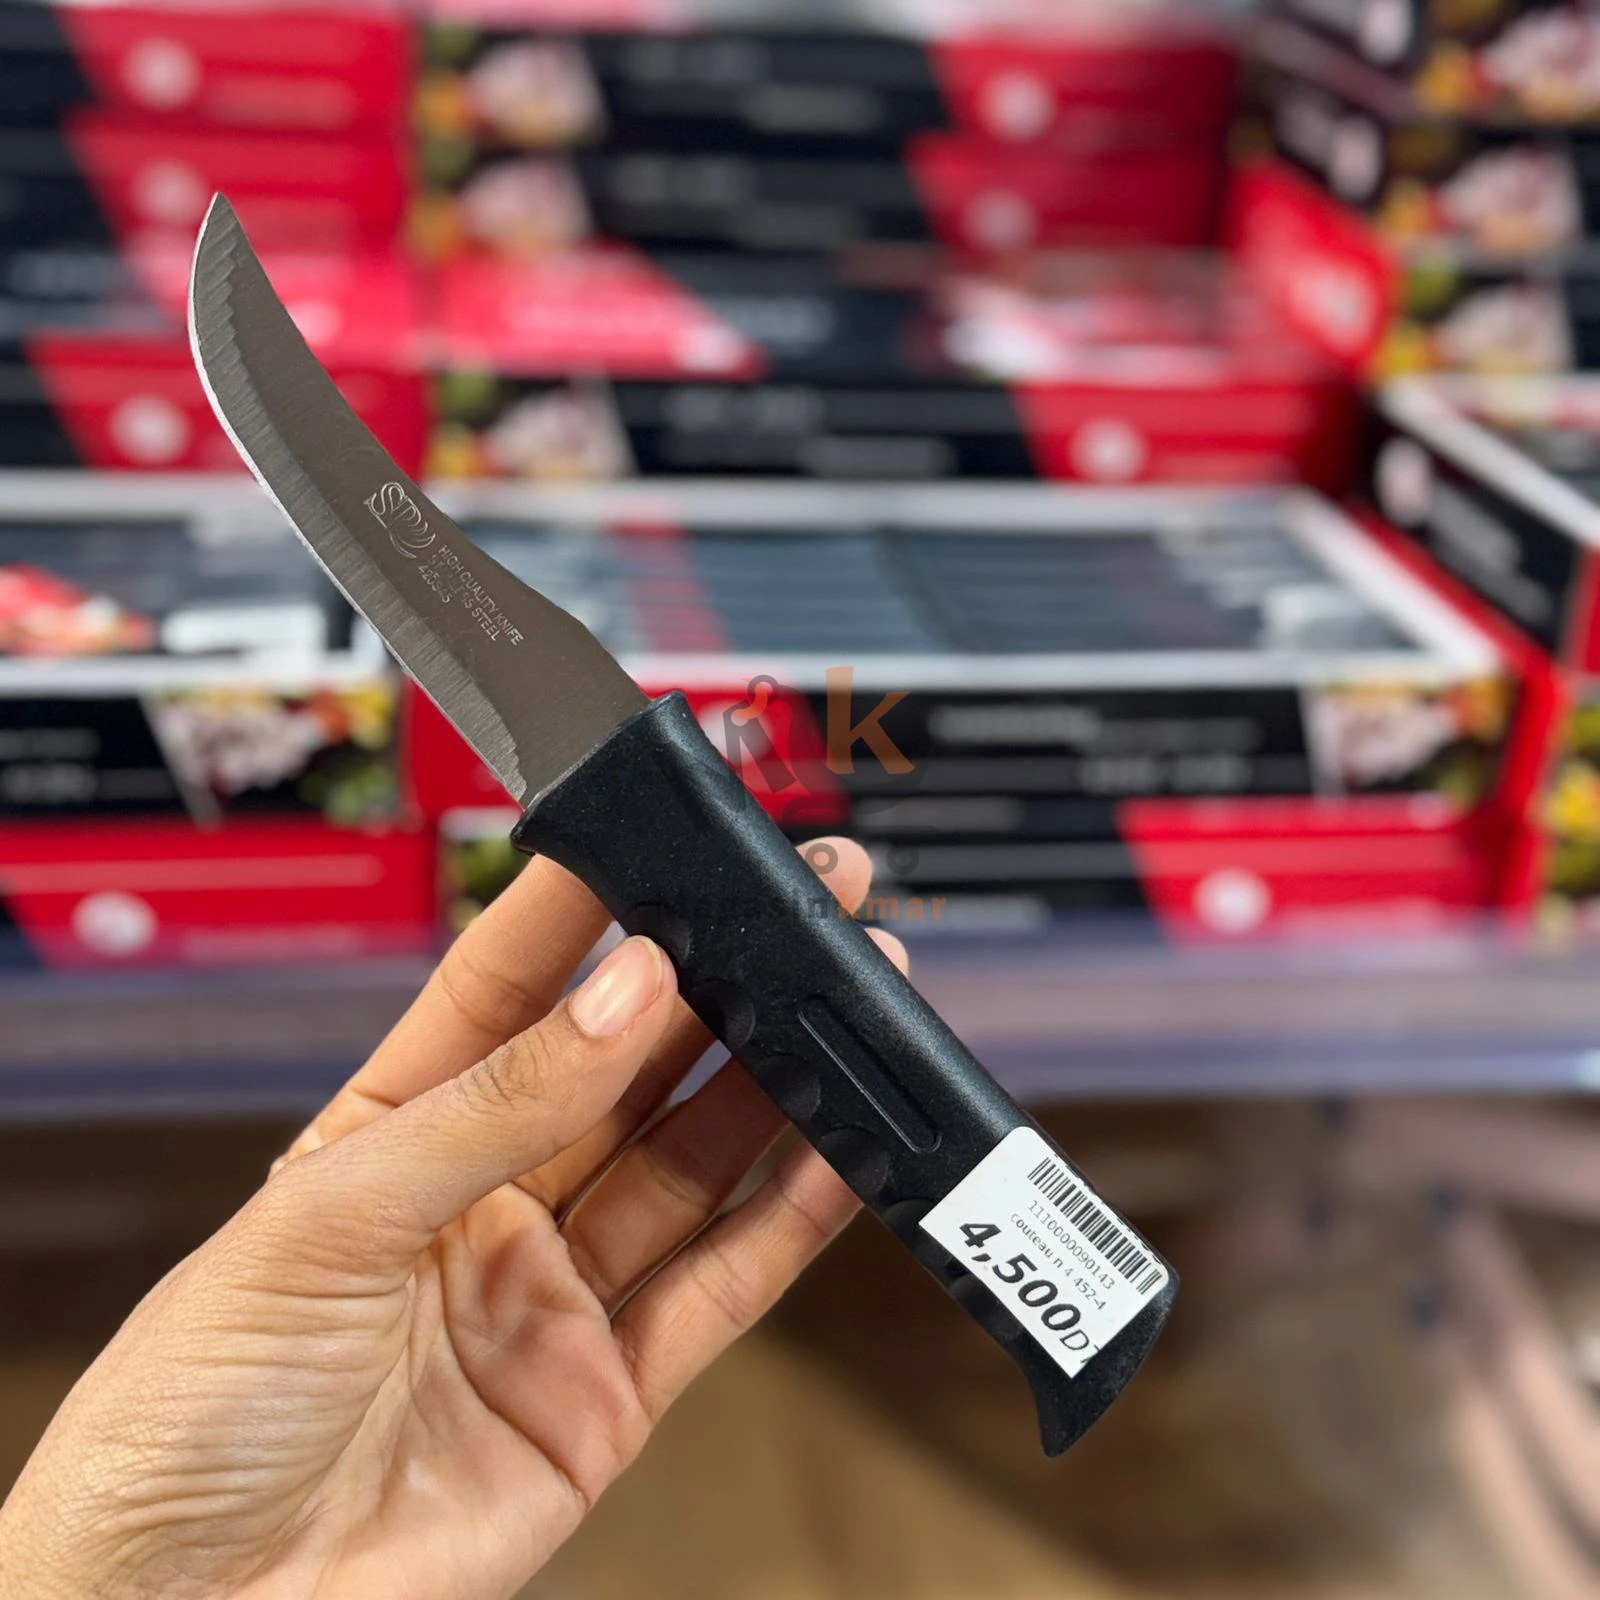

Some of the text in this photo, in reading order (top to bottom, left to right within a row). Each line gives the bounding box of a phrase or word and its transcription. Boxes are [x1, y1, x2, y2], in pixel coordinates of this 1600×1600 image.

[438, 544, 465, 574] HIGH
[494, 612, 524, 646] KNIFE
[471, 607, 501, 641] STEEL
[1010, 1213, 1053, 1258] couteau
[1052, 1256, 1064, 1270] n
[1064, 1266, 1075, 1278] 4
[1027, 1199, 1116, 1291] 1110000090143
